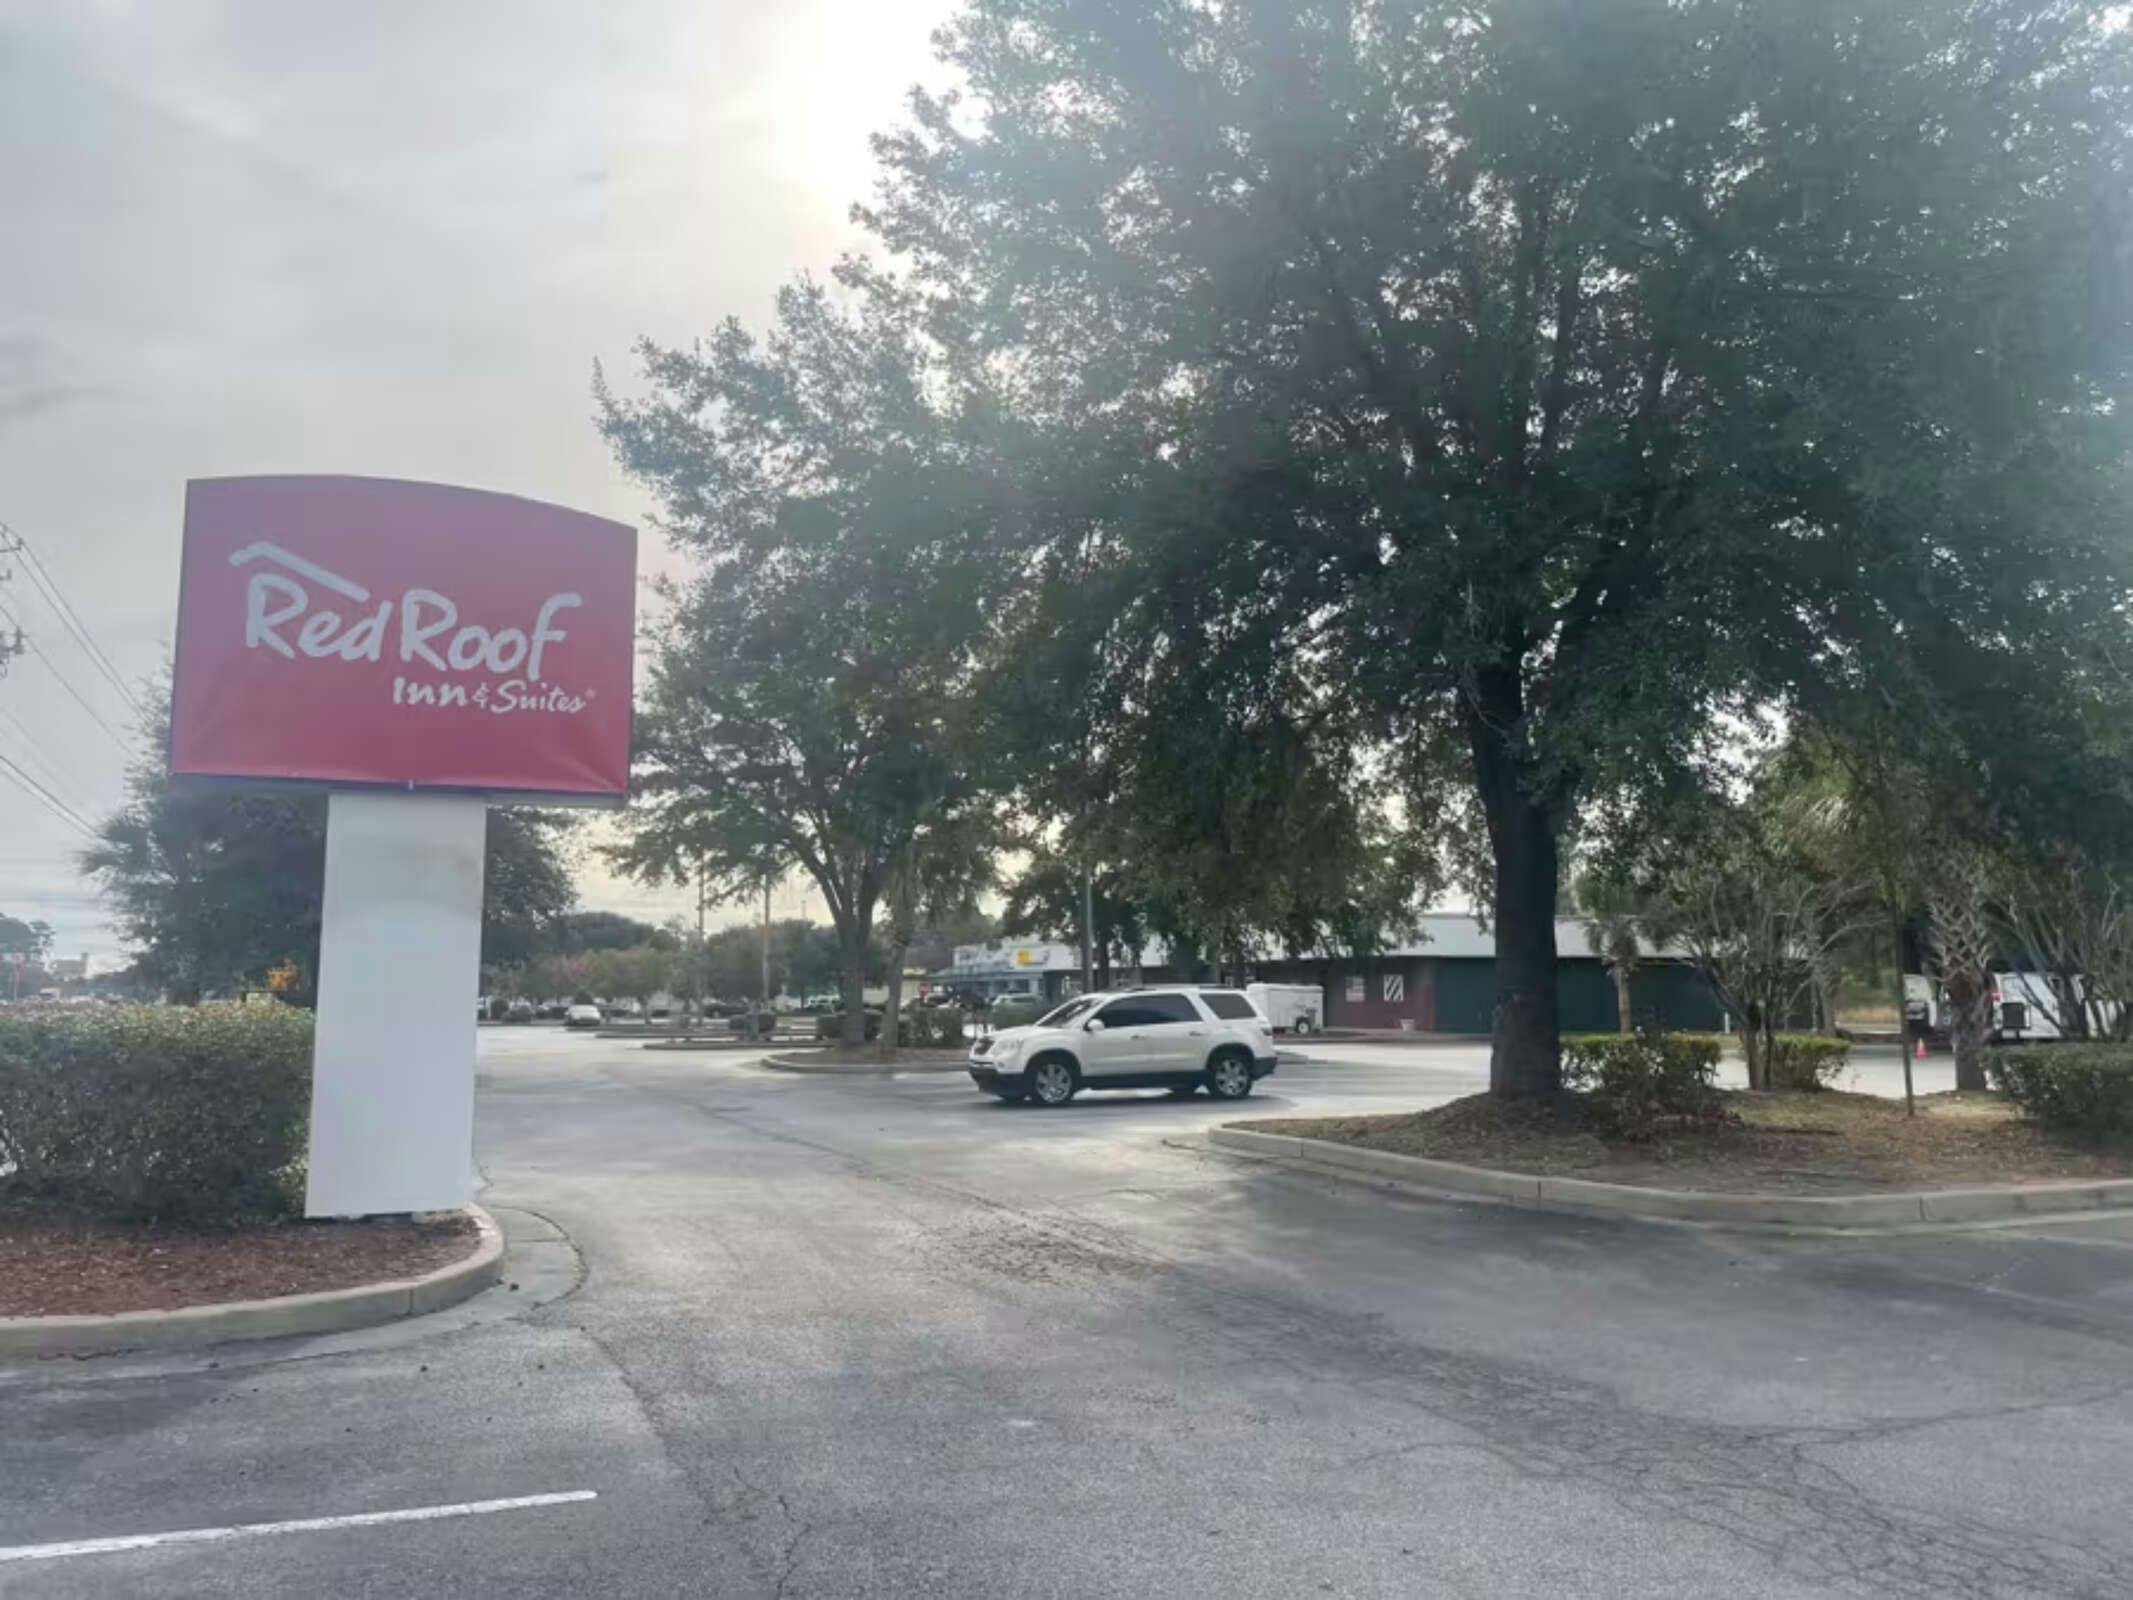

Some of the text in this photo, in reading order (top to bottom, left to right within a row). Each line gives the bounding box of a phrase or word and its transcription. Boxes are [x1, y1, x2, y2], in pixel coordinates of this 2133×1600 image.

[246, 572, 583, 681] Red Roof
[393, 676, 587, 713] Inn & Suites
